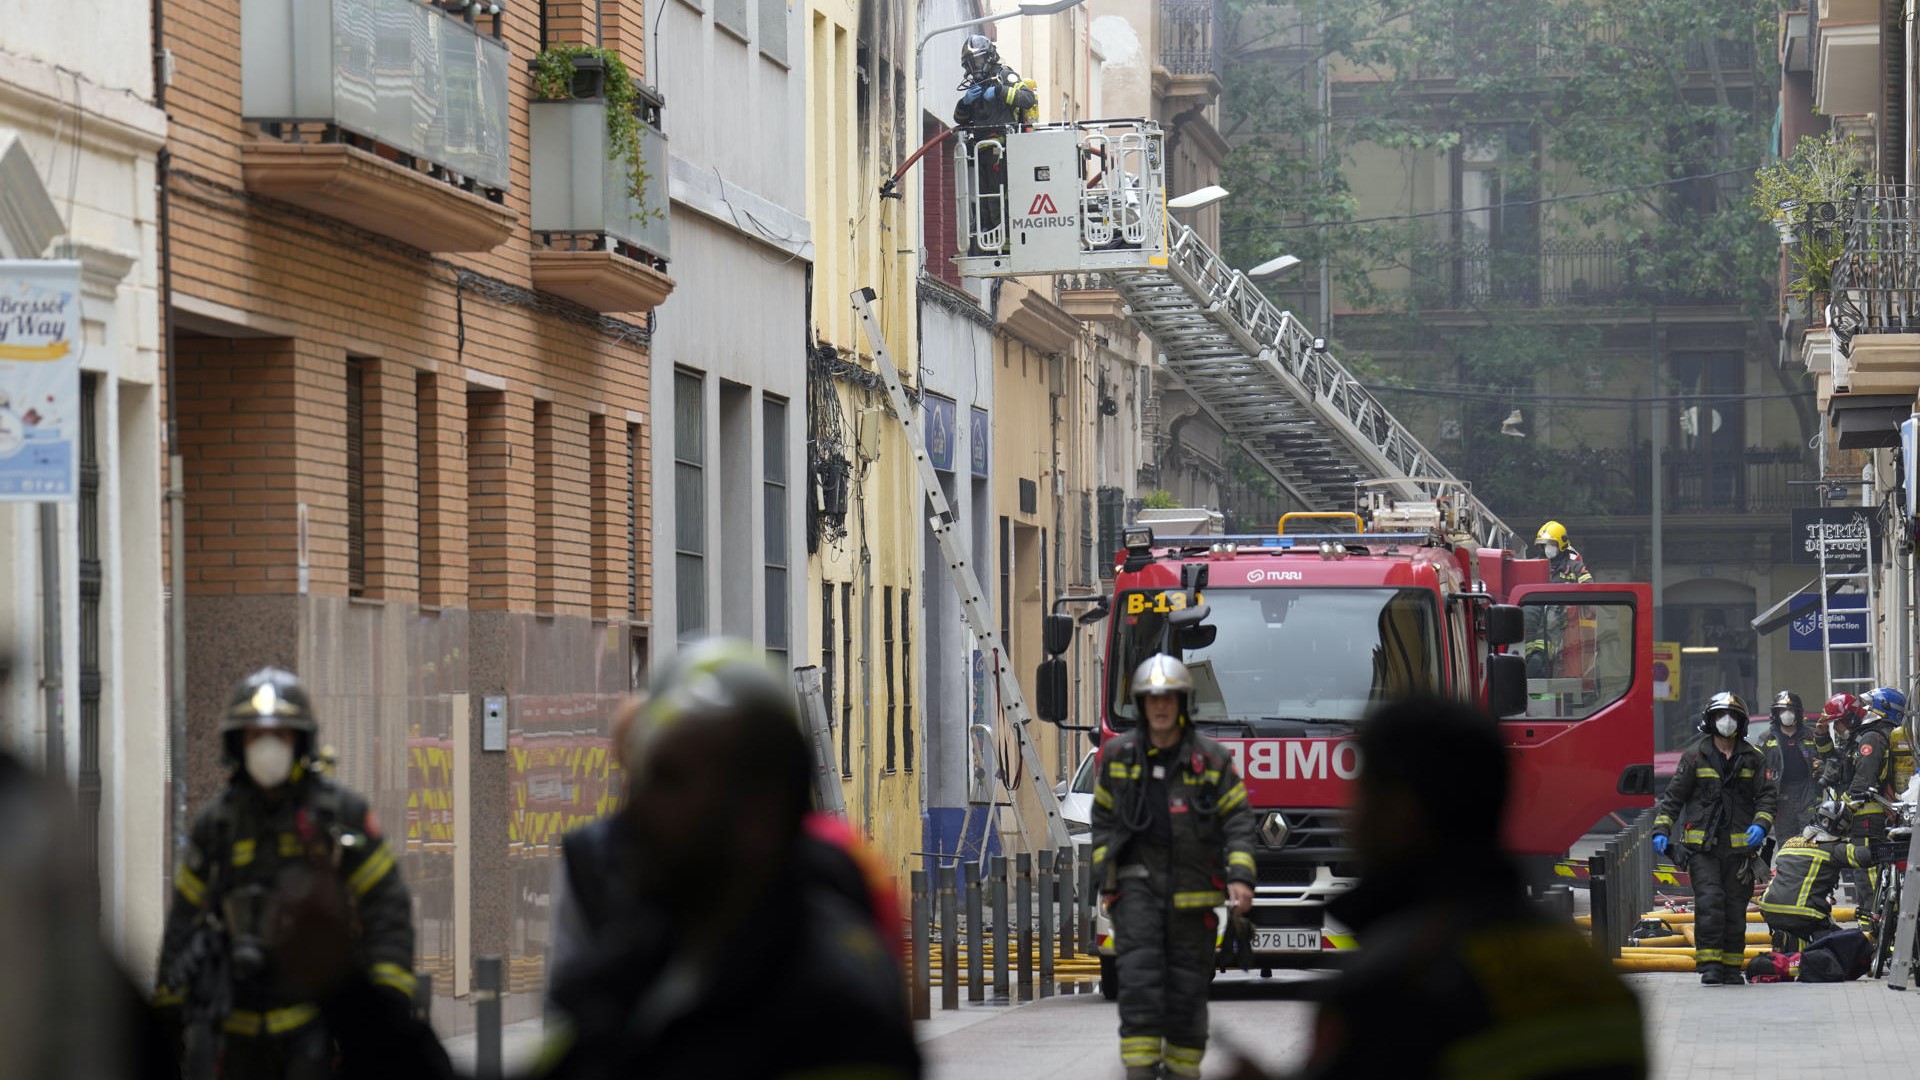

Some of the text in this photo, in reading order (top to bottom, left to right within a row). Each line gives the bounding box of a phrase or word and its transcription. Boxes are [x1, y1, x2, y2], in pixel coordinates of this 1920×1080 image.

[1012, 216, 1075, 229] MAGIRUS
[0, 315, 66, 341] y Way
[1805, 523, 1867, 539] TERRA
[1267, 571, 1302, 580] ITURRI
[1818, 622, 1860, 630] Cnnection
[1251, 933, 1317, 948] 878 LDW
